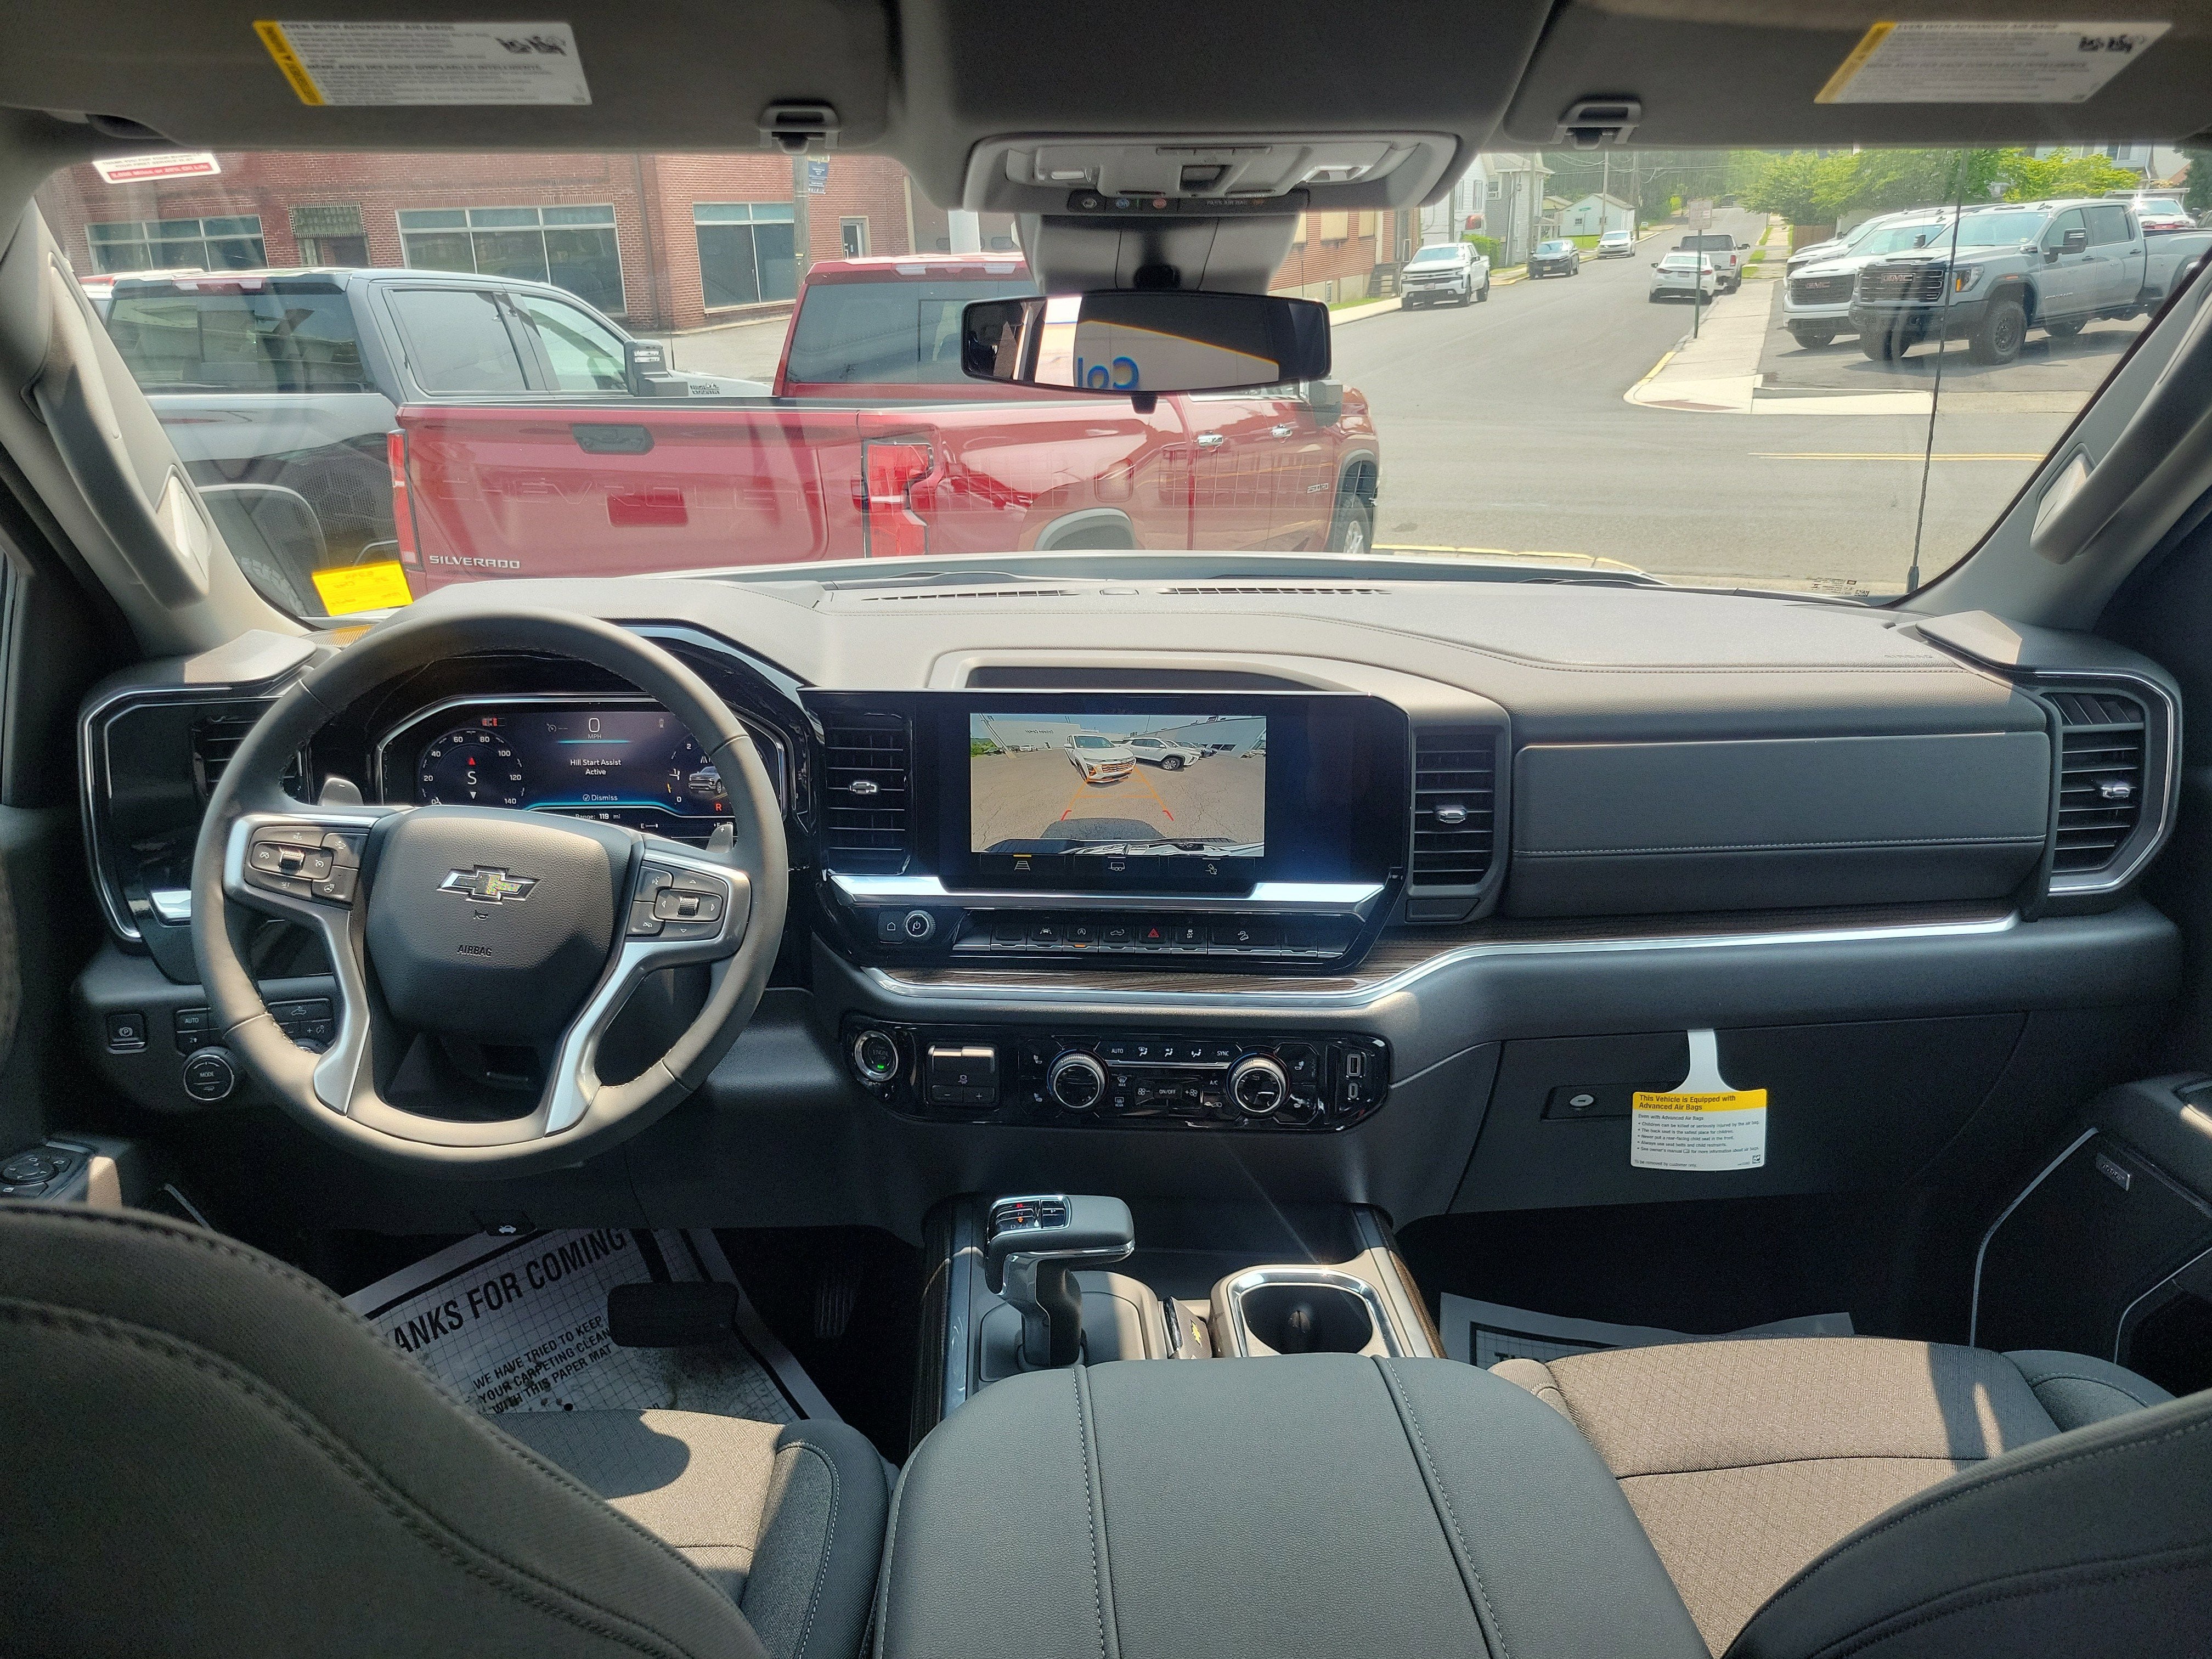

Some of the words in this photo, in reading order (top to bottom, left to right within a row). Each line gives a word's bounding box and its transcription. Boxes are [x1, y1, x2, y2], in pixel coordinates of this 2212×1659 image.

[1882, 274, 1914, 283] GMC
[429, 555, 520, 569] SILVERADO
[589, 718, 600, 732] 0
[467, 771, 477, 785] S
[715, 803, 722, 811] R
[457, 944, 493, 957] AIRBAG
[1639, 1102, 1672, 1110] Advanced
[466, 1272, 523, 1320] FOR
[525, 1227, 627, 1290] COMING
[473, 1372, 493, 1389] WE
[494, 1356, 524, 1379] HAVE
[524, 1339, 557, 1363] TRIED
[558, 1331, 574, 1345] TO
[575, 1316, 603, 1337] KEEP
[478, 1380, 513, 1403] YOUR
[513, 1347, 575, 1387] CARPETING
[575, 1328, 611, 1353] CLEAN
[492, 1394, 523, 1414] WITH
[524, 1377, 551, 1397] THIS
[551, 1358, 589, 1383] PAPER
[588, 1344, 613, 1363] MAT
